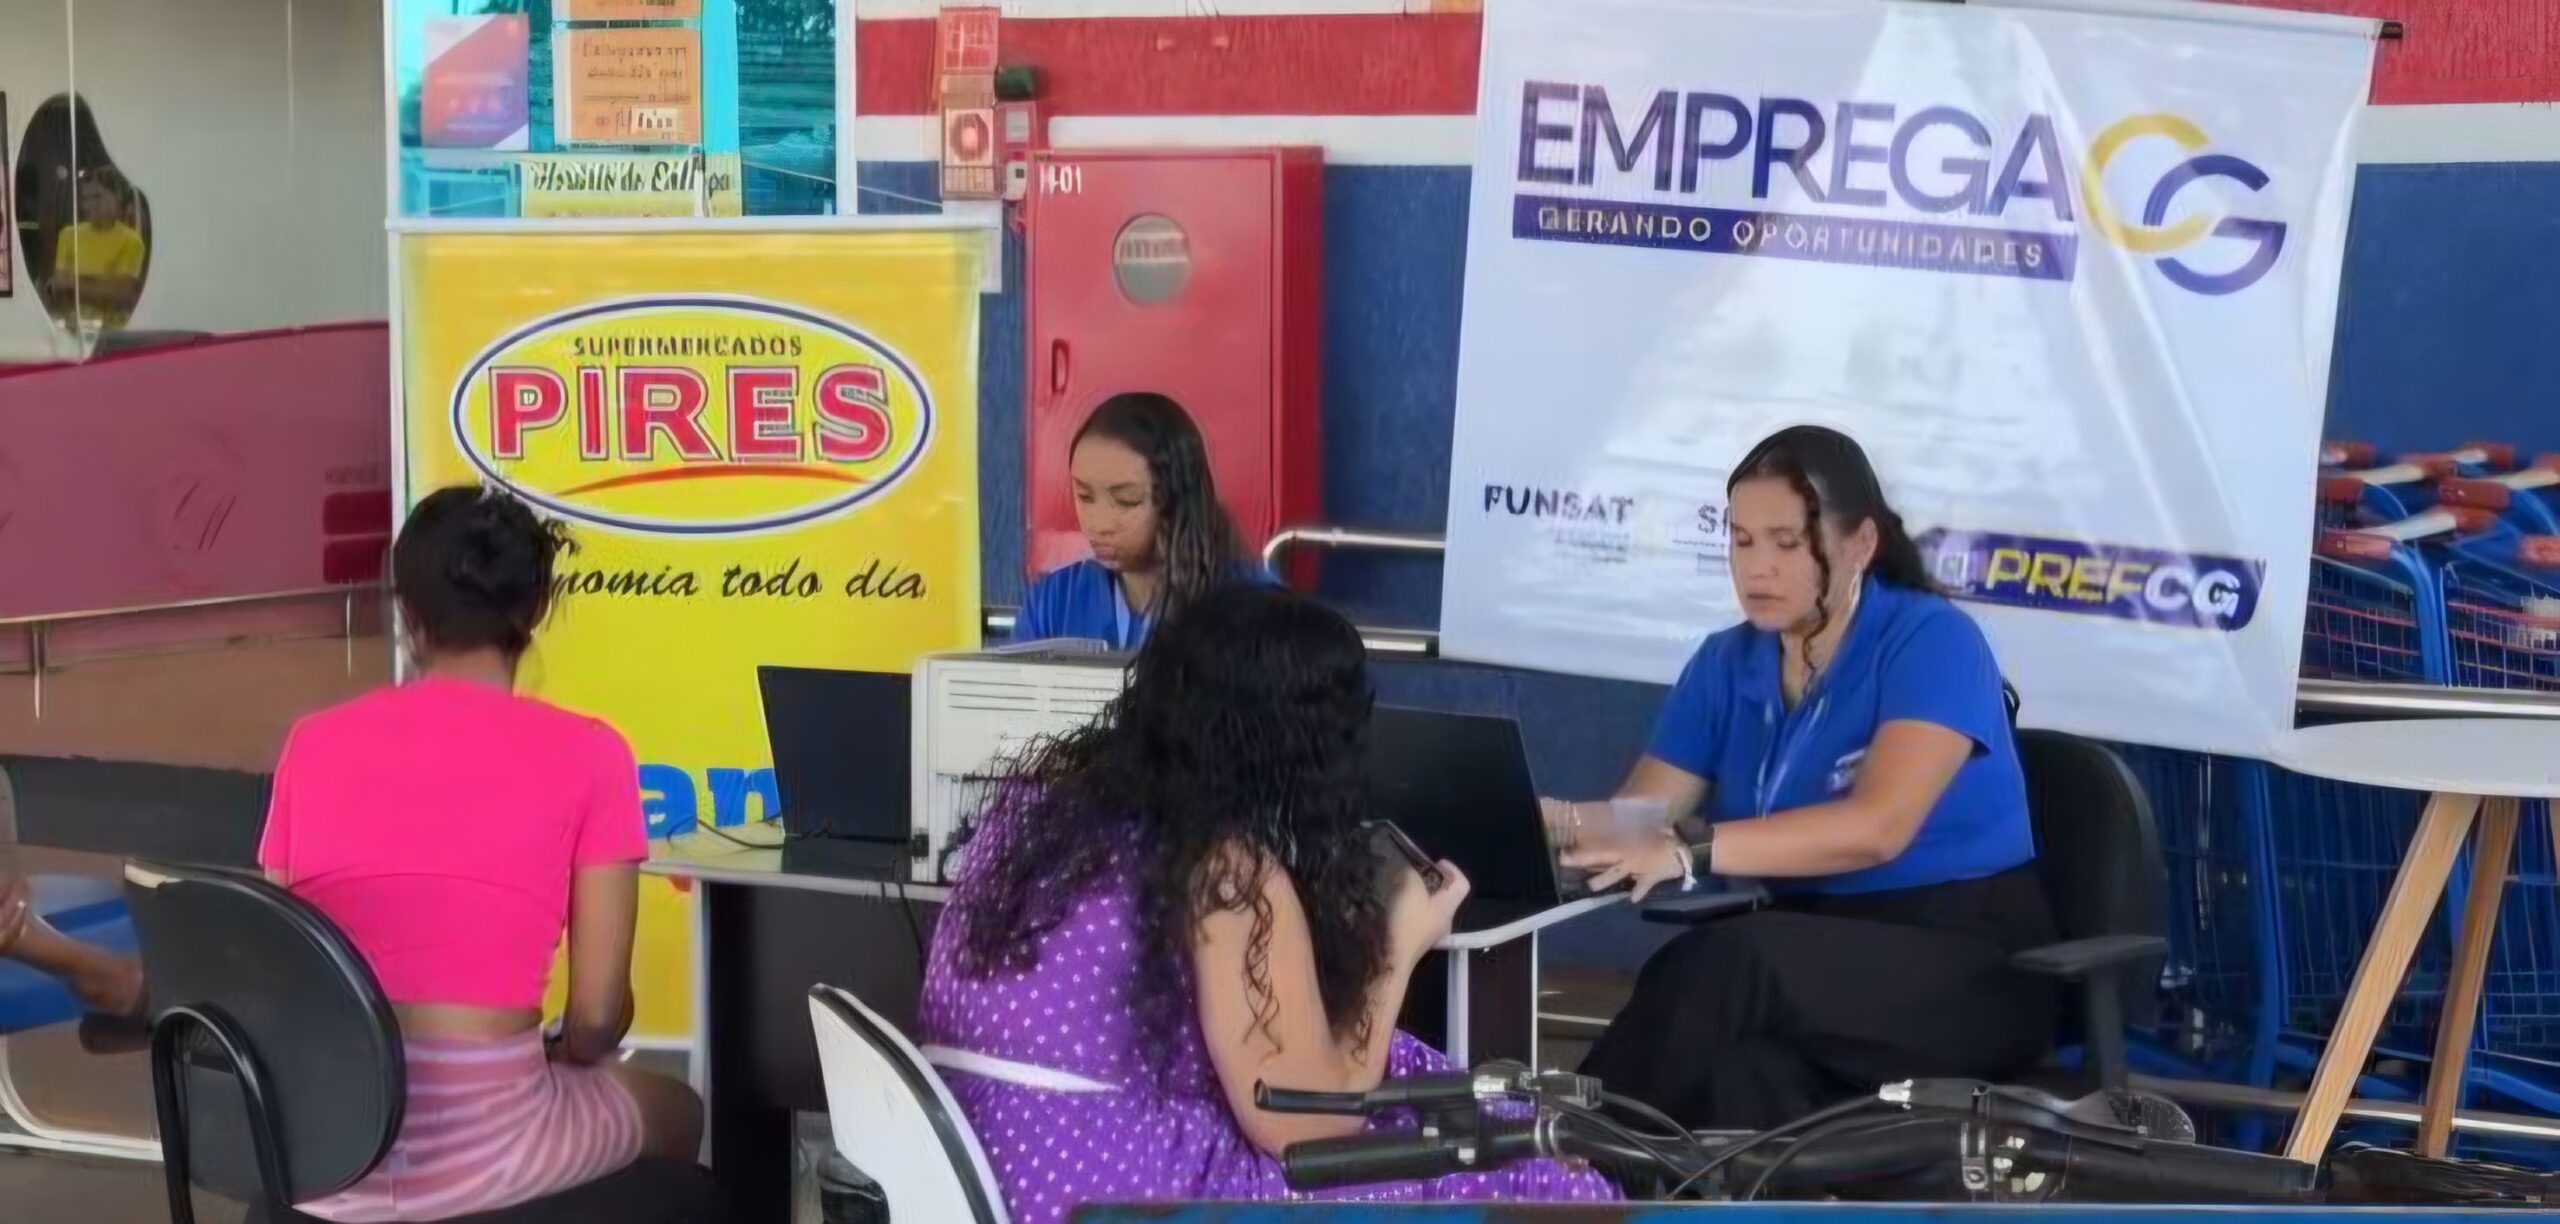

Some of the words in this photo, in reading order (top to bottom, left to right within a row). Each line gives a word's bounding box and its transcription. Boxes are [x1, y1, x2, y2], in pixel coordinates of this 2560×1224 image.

[1516, 79, 2075, 223] EMPREGA
[487, 364, 892, 463] PIRES
[1484, 484, 1634, 524] FUNSAT
[722, 559, 823, 599] todo
